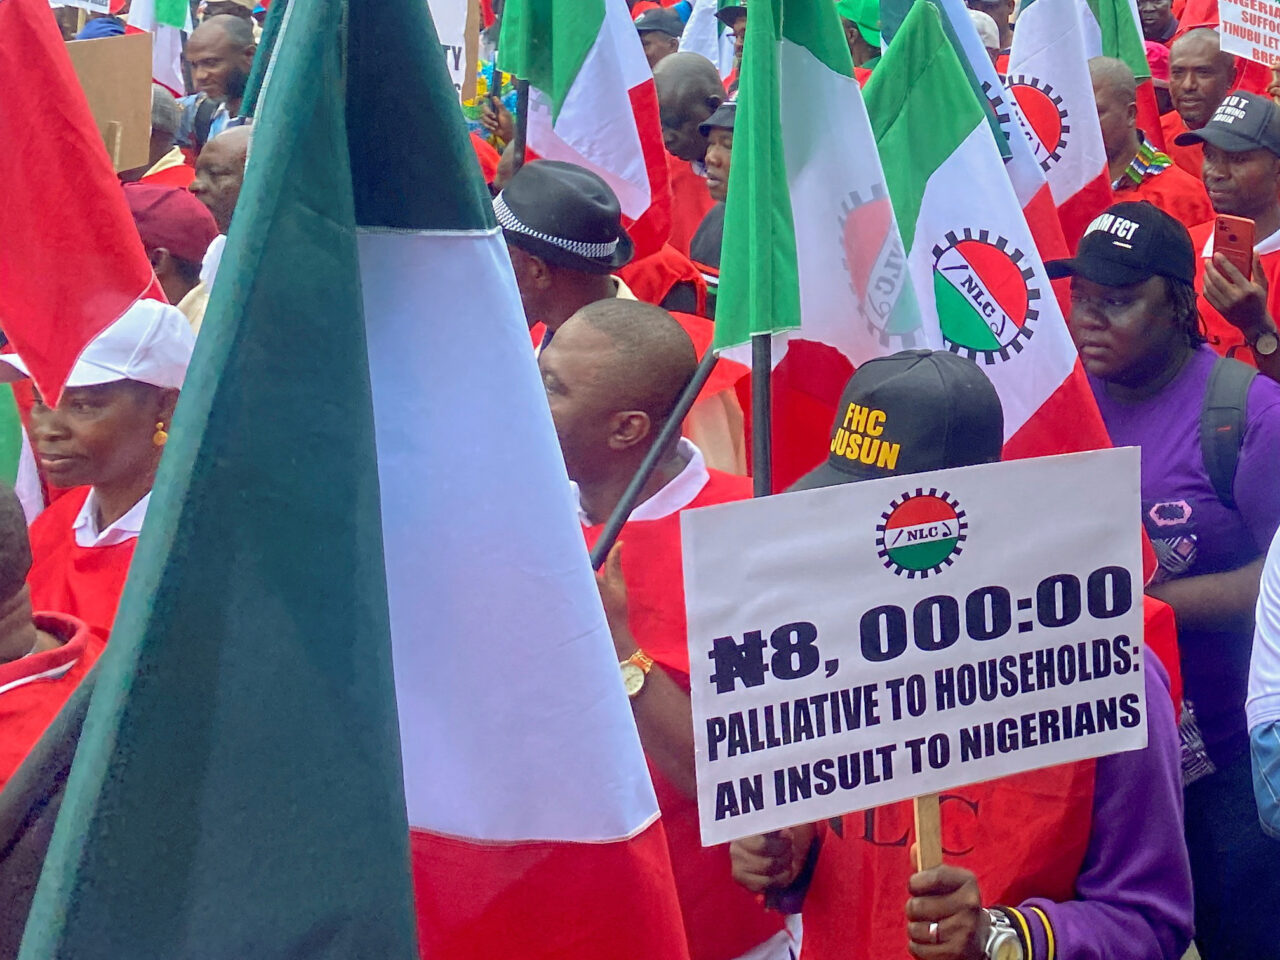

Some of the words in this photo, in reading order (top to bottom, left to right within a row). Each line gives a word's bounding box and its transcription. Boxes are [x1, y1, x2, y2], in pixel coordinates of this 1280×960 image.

[1222, 20, 1260, 44] TINUBU
[1263, 34, 1280, 50] LET
[1110, 217, 1140, 240] FCT
[960, 274, 996, 318] NLC
[843, 402, 886, 436] FHC
[830, 428, 900, 470] JUSUN
[906, 524, 939, 542] NLC
[860, 565, 1133, 664] 000:00
[706, 681, 882, 763] PALLIATIVE
[886, 672, 927, 722] TO
[934, 634, 1142, 713] HOUSEHOLDS:
[714, 773, 764, 820] AN
[774, 744, 897, 806] INSULT
[904, 732, 952, 775] TO
[960, 693, 1142, 763] NIGERIANS
